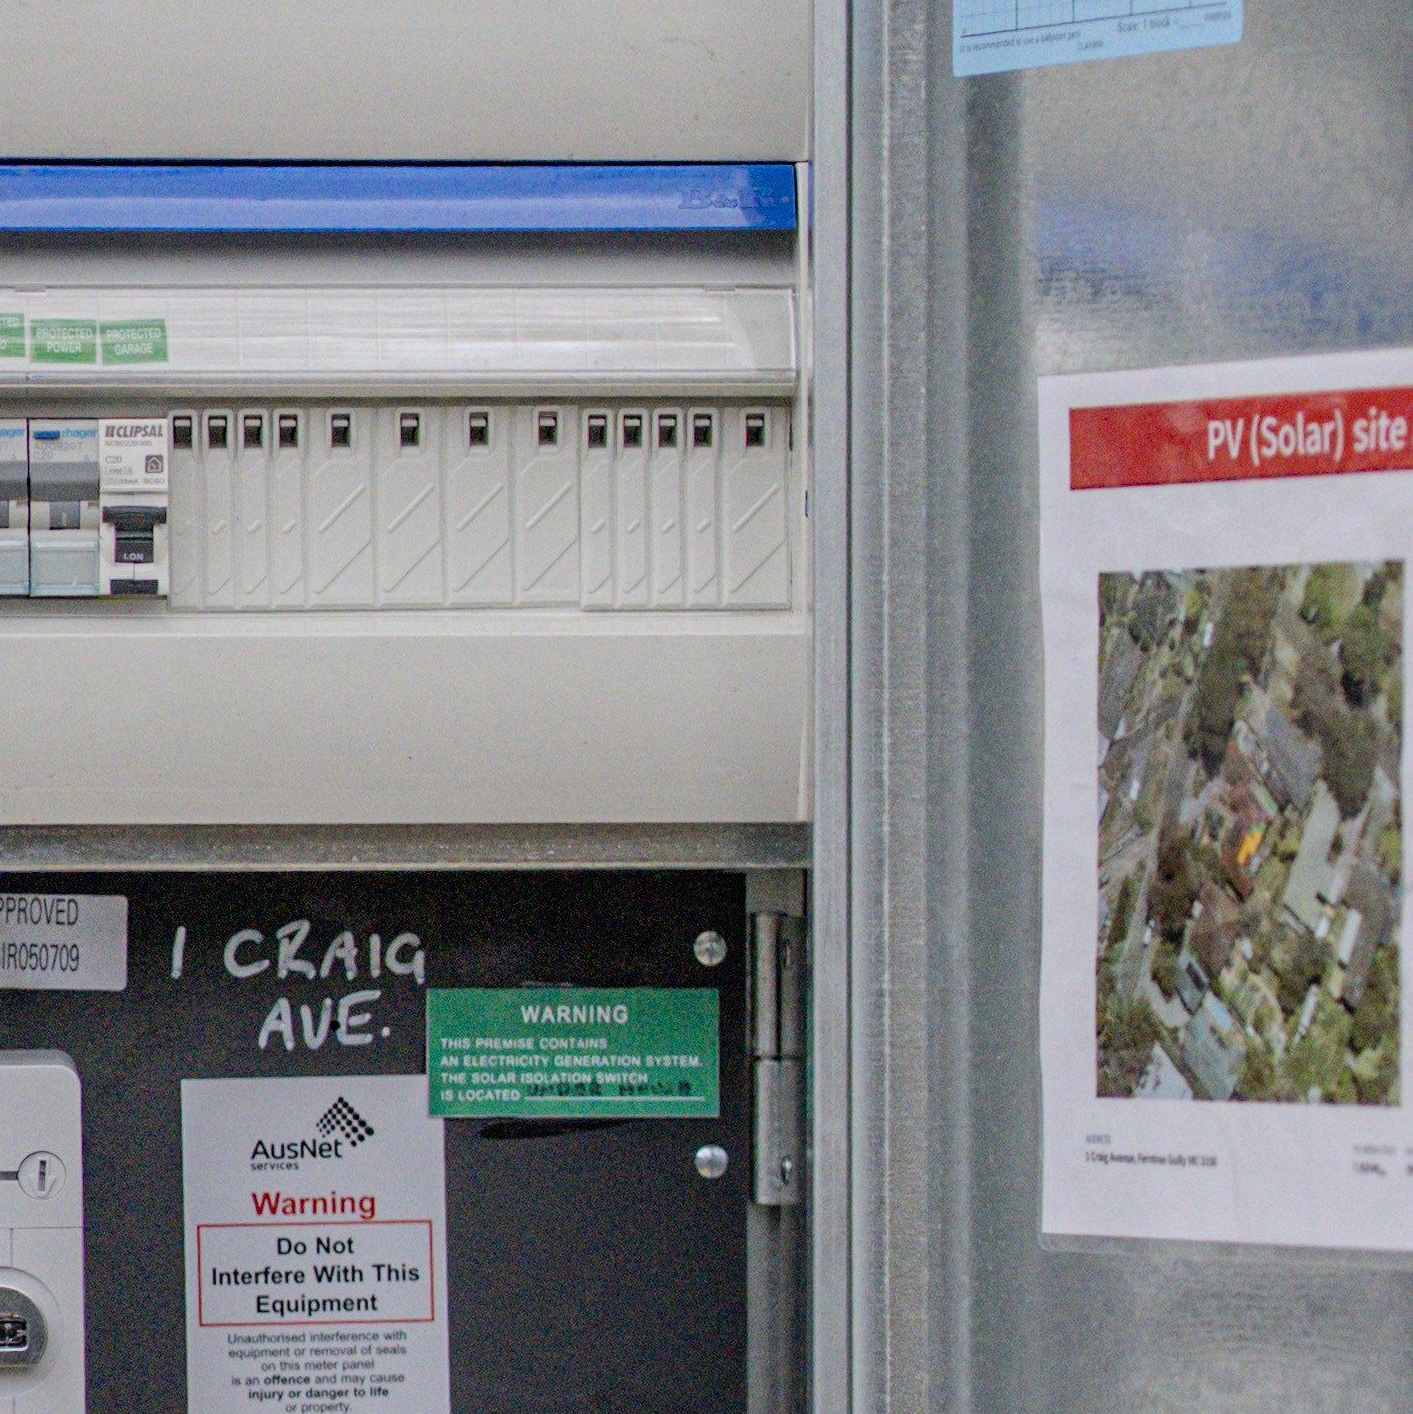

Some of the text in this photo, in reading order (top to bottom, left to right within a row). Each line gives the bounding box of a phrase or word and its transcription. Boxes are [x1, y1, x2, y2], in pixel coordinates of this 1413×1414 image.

[36, 328, 93, 339] PROTECTED
[106, 328, 161, 339] PROTECTED
[47, 342, 82, 353] POWER
[114, 342, 154, 355] GARAGE
[1207, 407, 1407, 467] PV (Solar) site
[106, 456, 122, 464] C20
[224, 918, 425, 984] CRAIG
[259, 989, 391, 1051] AVE.
[521, 1005, 628, 1023] WARNING
[441, 1038, 607, 1049] THIS PREMISE CONTAINS
[441, 1056, 459, 1067] AN
[463, 1055, 548, 1067] ELECTRICITY
[554, 1055, 641, 1067] GENERATION
[441, 1073, 648, 1084] THE SOLAR ISOLATION SWITCH
[441, 1090, 453, 1101] IS
[459, 1090, 520, 1101] LOCATED
[251, 1138, 342, 1160] AusNet
[251, 1162, 299, 1170] services
[252, 1191, 376, 1219] Warning
[277, 1237, 354, 1256] Do Not
[212, 1262, 420, 1285] Interfere With This
[256, 1295, 378, 1317] Equipment
